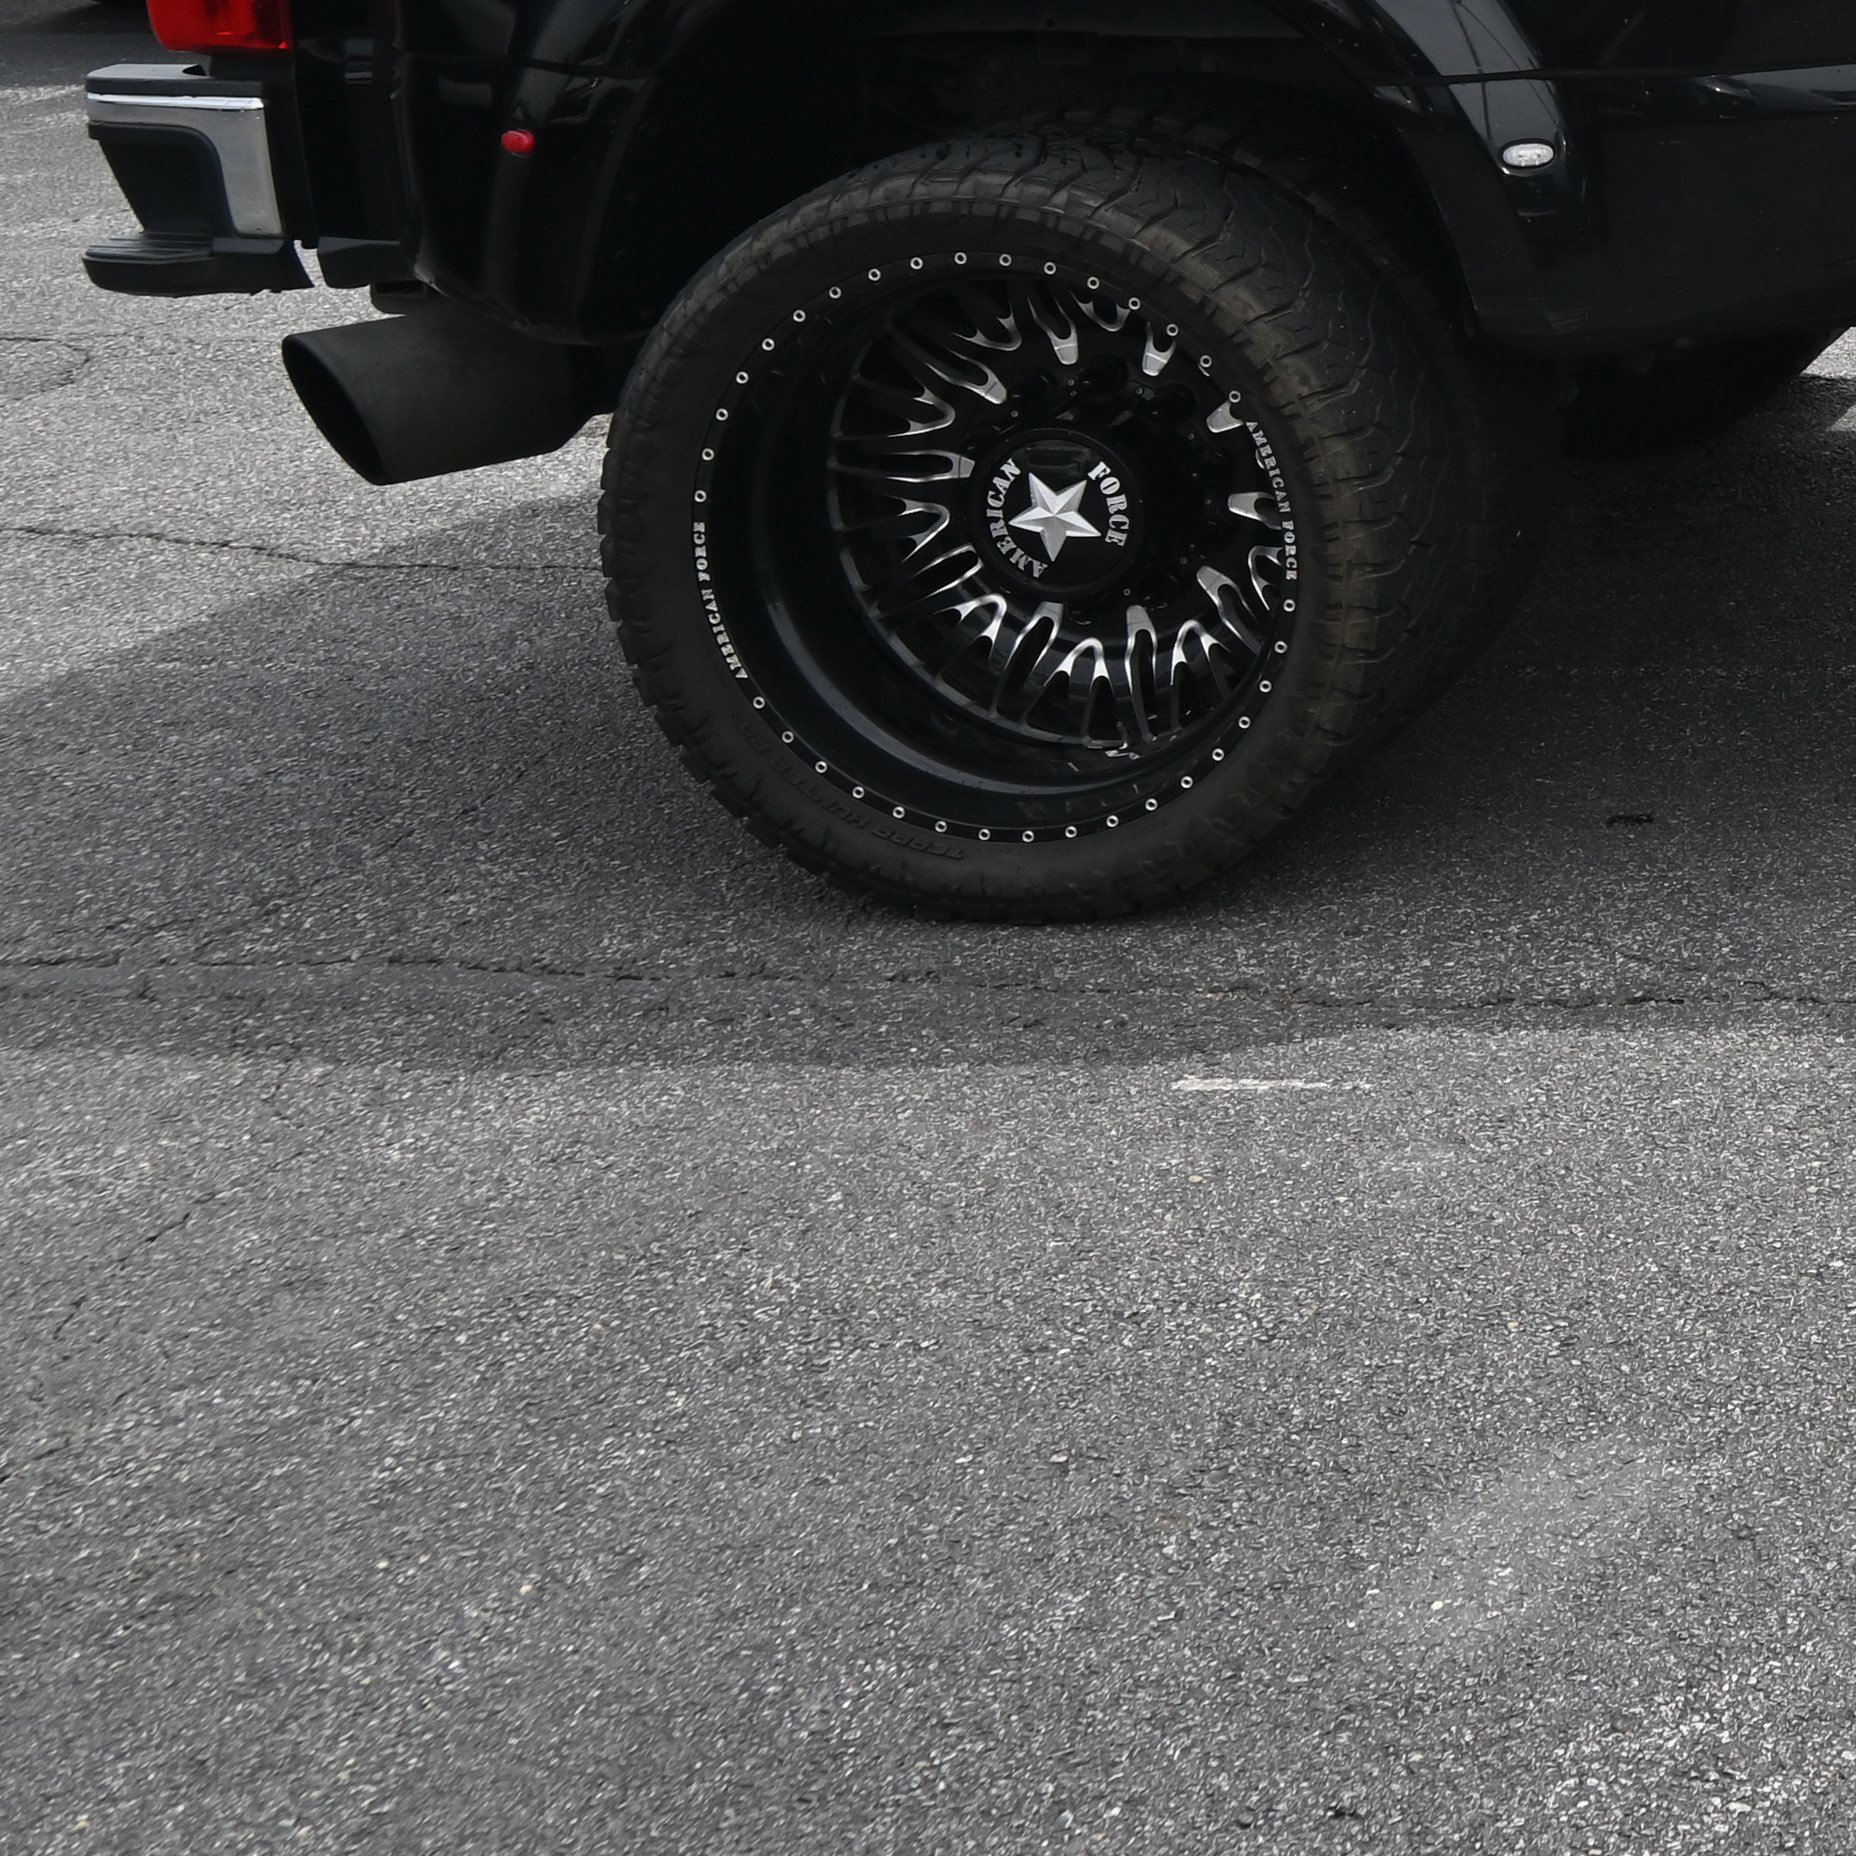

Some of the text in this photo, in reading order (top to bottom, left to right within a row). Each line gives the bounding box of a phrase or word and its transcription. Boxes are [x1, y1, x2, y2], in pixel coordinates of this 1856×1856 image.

[986, 458, 1130, 578] AMERICAN FORCE
[1245, 421, 1298, 581] AMERICAN FORCE
[693, 521, 748, 679] AMERICAN FORCE
